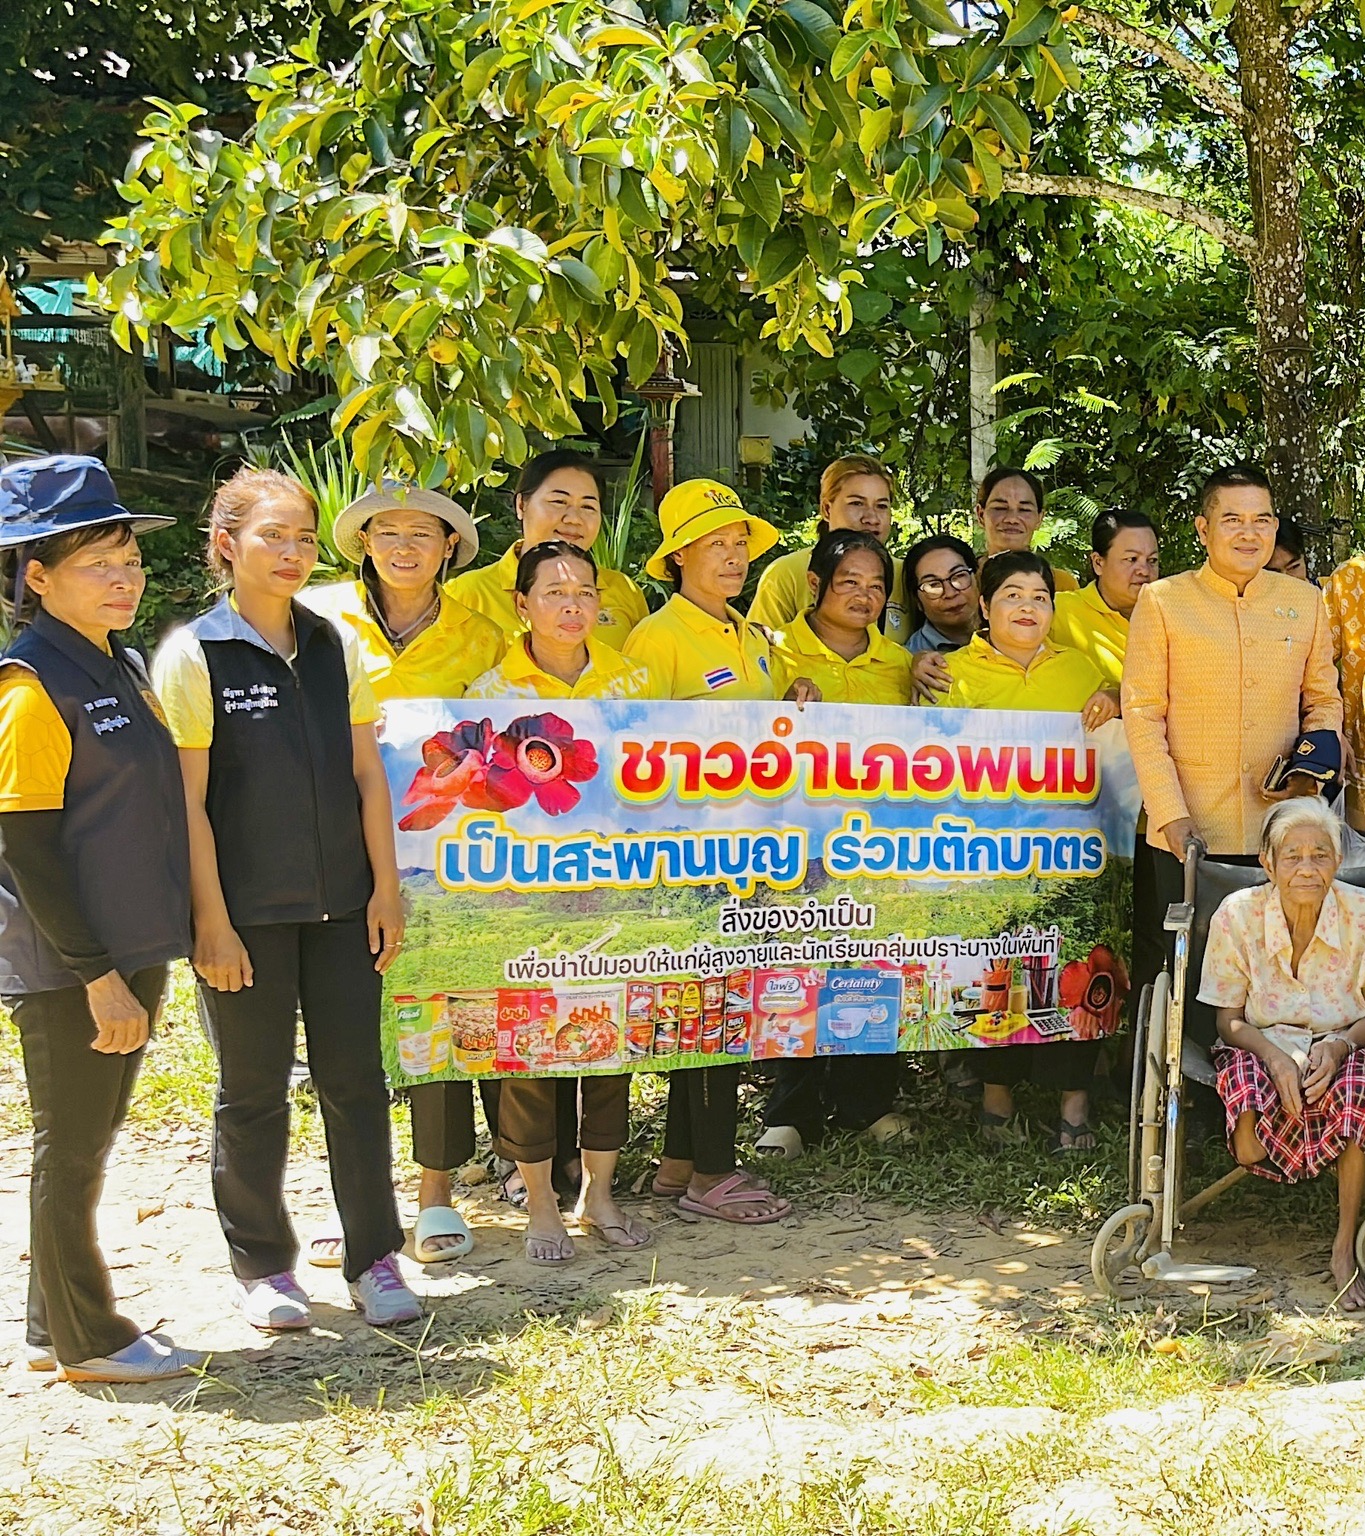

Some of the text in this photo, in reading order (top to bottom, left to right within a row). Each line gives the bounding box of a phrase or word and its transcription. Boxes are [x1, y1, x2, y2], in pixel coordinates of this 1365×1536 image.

[620, 716, 1096, 794] ชาวอำเภอพนม
[444, 818, 1103, 889] เป็นสะพานบุญ ร่วมตักบาตร
[722, 897, 873, 933] สิ่งของจำเป็น
[507, 926, 1056, 980] เพื่อนำไปมอบให้แก่ผู้สูงอายุและนักเรียนกลุ่มเปราะบางในพื้นที่
[831, 978, 882, 992] Certainty
[569, 1001, 611, 1024] มาม่า
